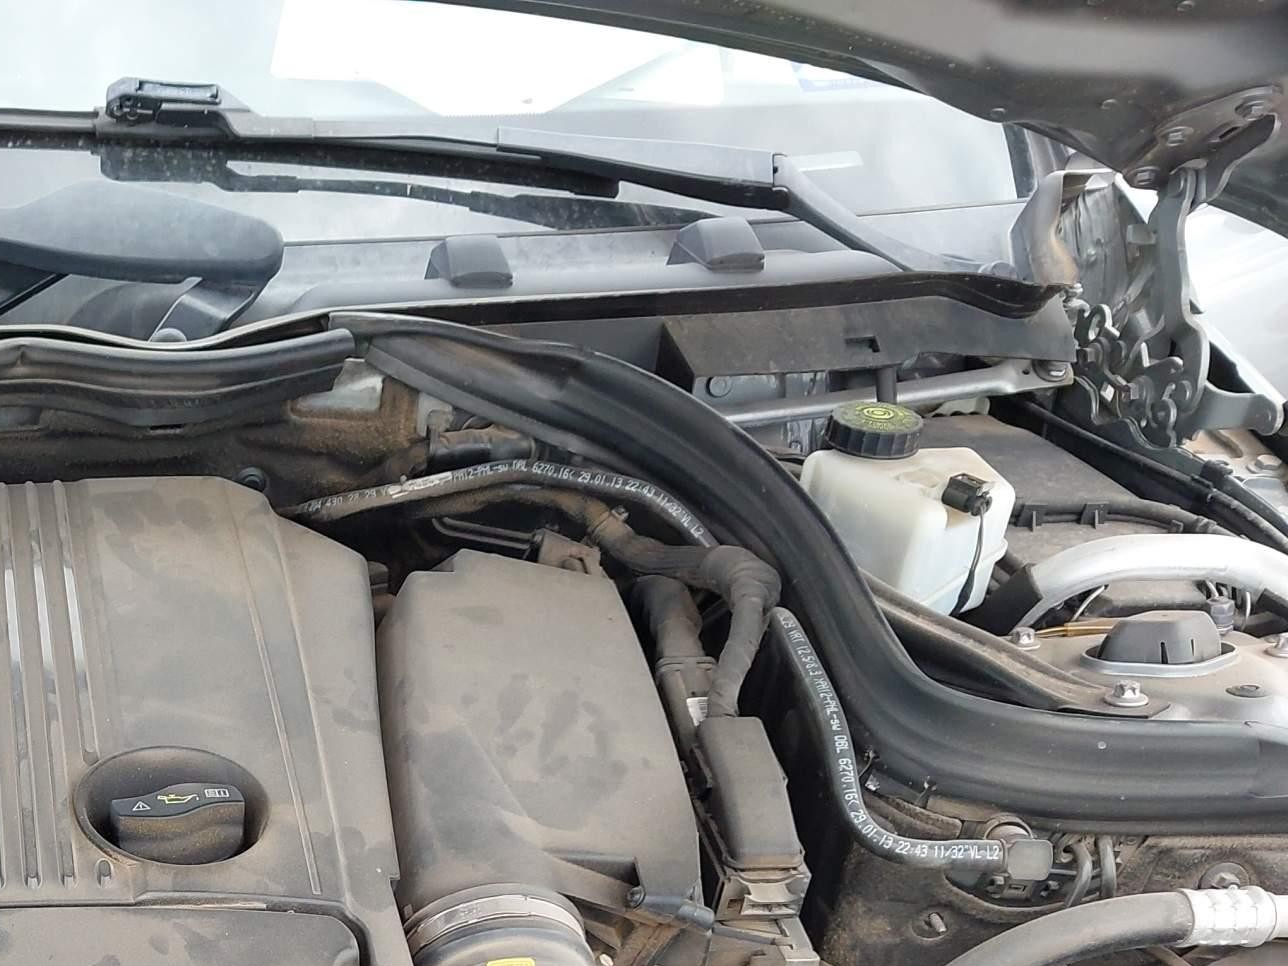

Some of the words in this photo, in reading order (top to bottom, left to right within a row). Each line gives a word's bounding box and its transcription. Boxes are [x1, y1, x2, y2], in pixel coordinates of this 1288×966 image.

[577, 470, 622, 489] 29.01.13
[849, 807, 893, 849] 29.01.13
[895, 840, 928, 857] 22:43
